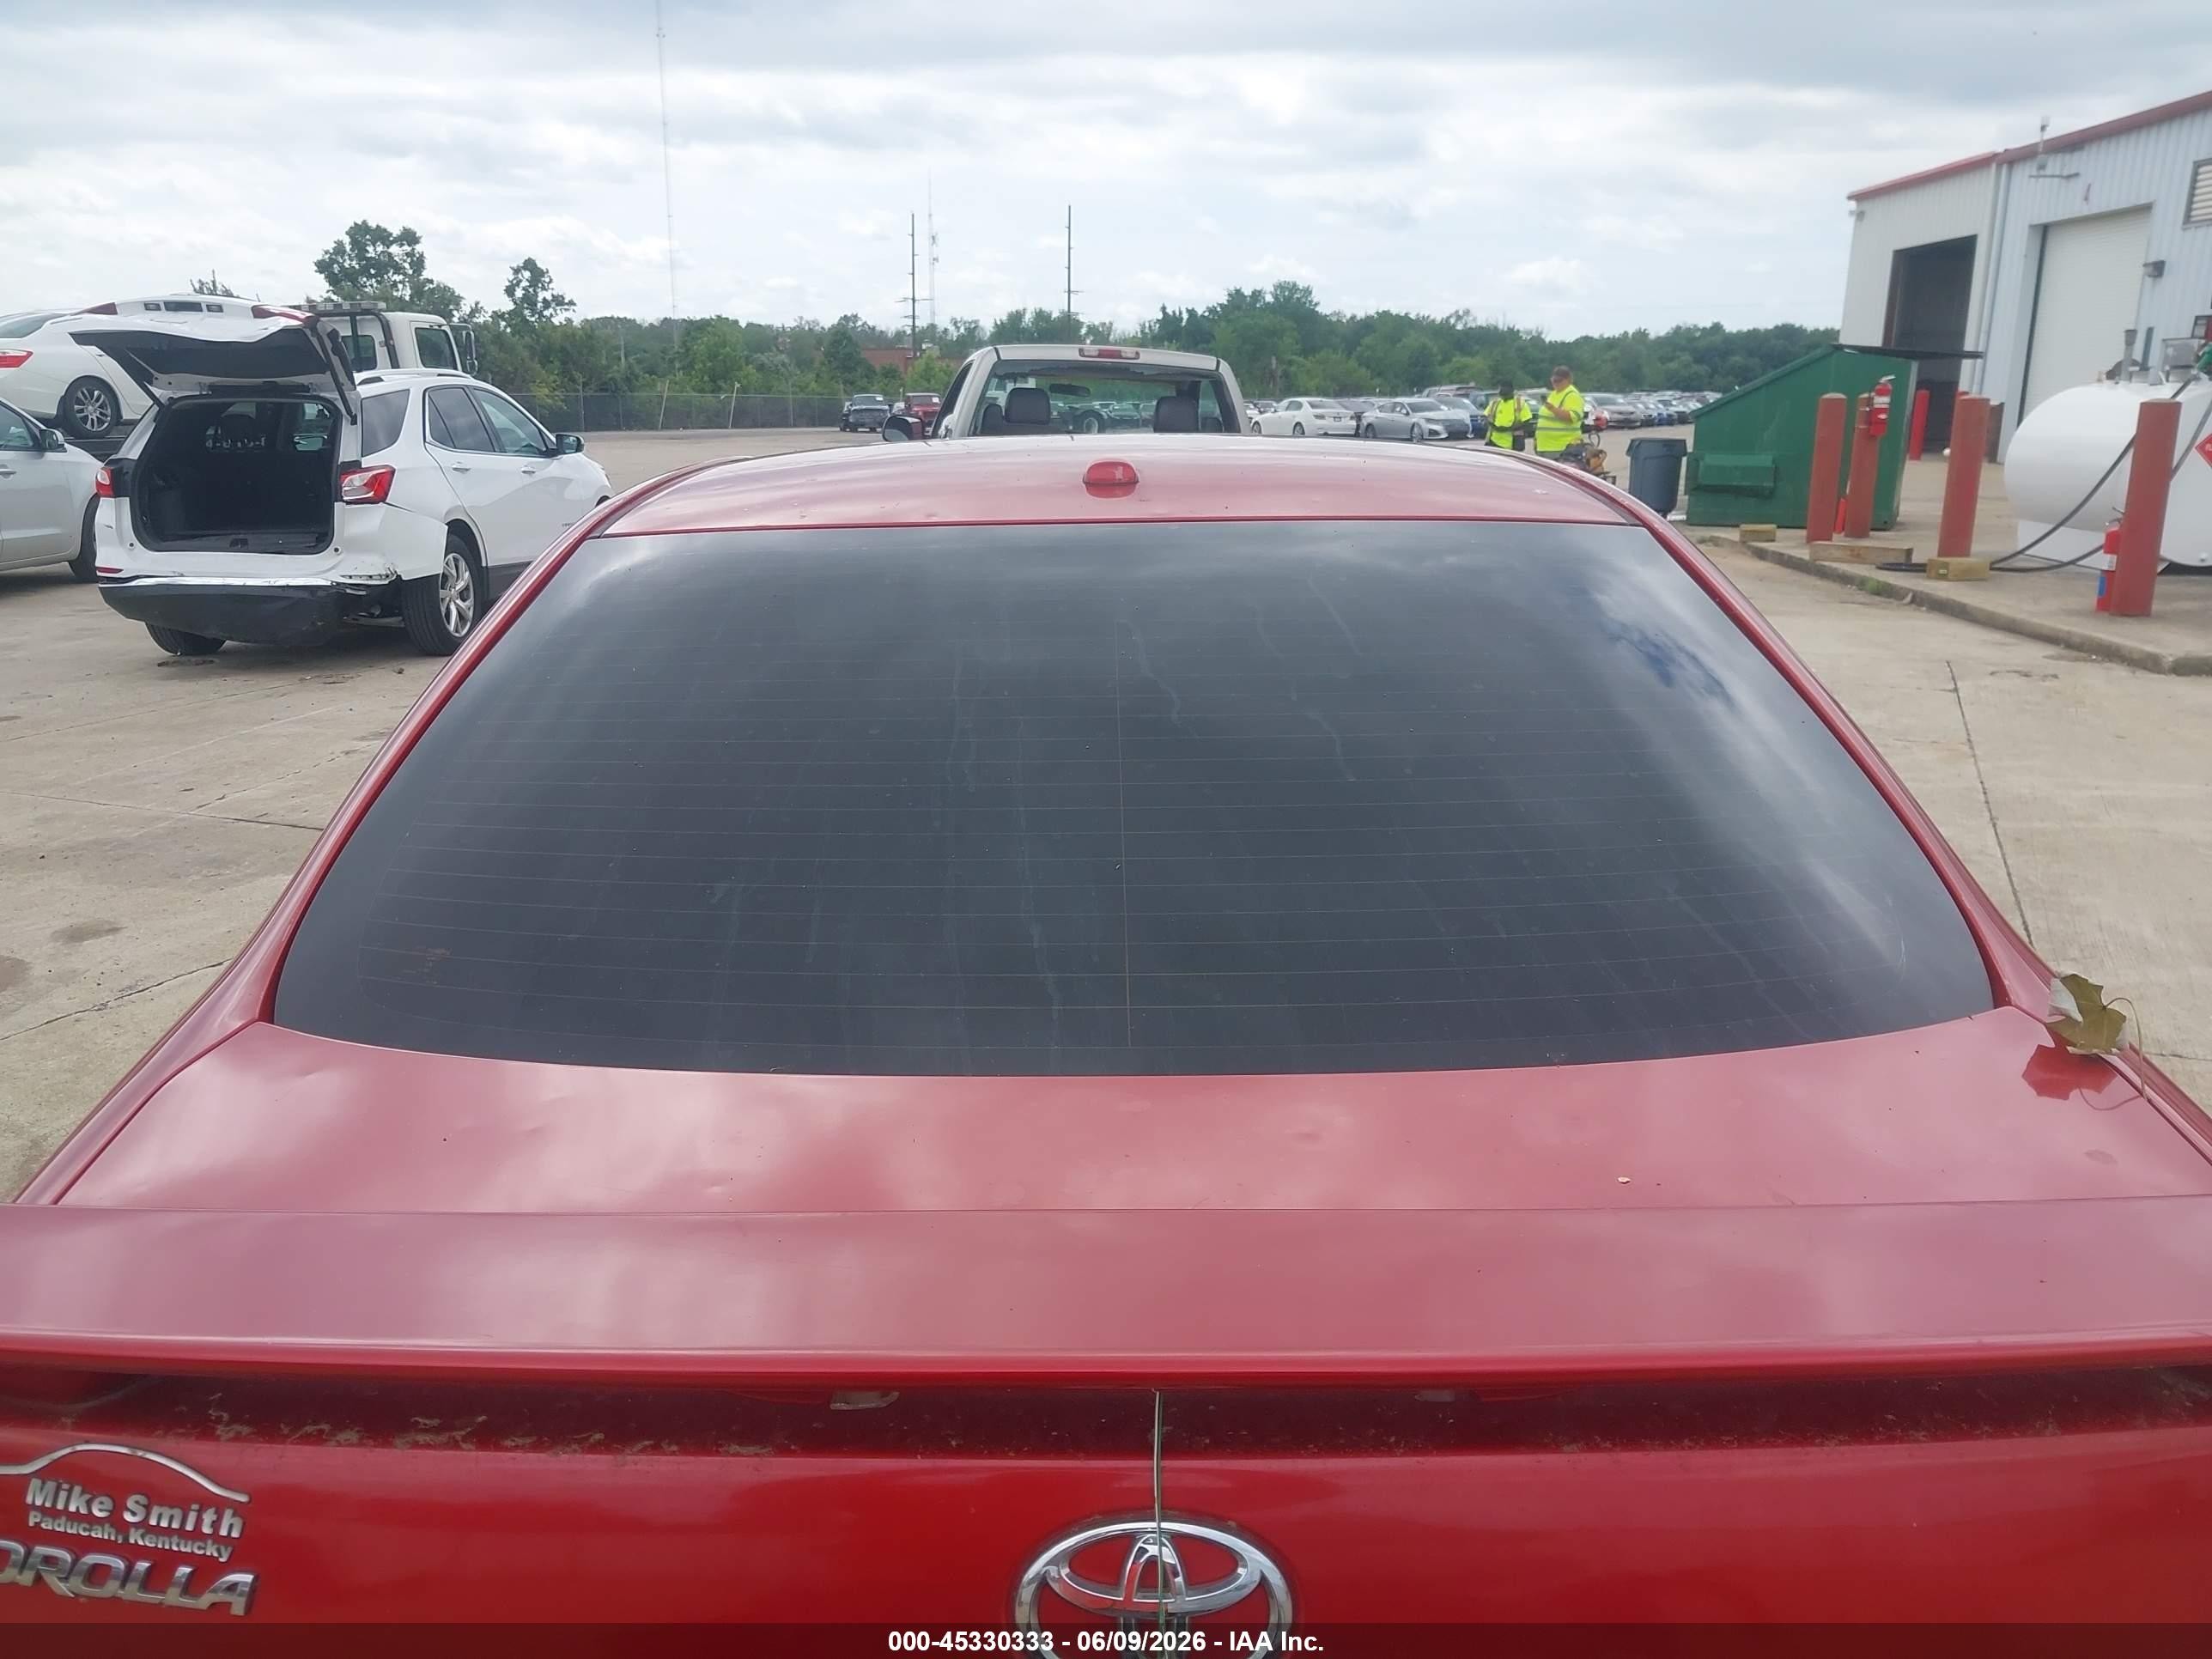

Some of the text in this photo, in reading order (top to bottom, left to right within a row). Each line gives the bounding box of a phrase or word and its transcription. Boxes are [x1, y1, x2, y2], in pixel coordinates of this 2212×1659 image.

[26, 1478, 244, 1538] Mike Smith
[28, 1511, 233, 1562] Paducah, Kentucky
